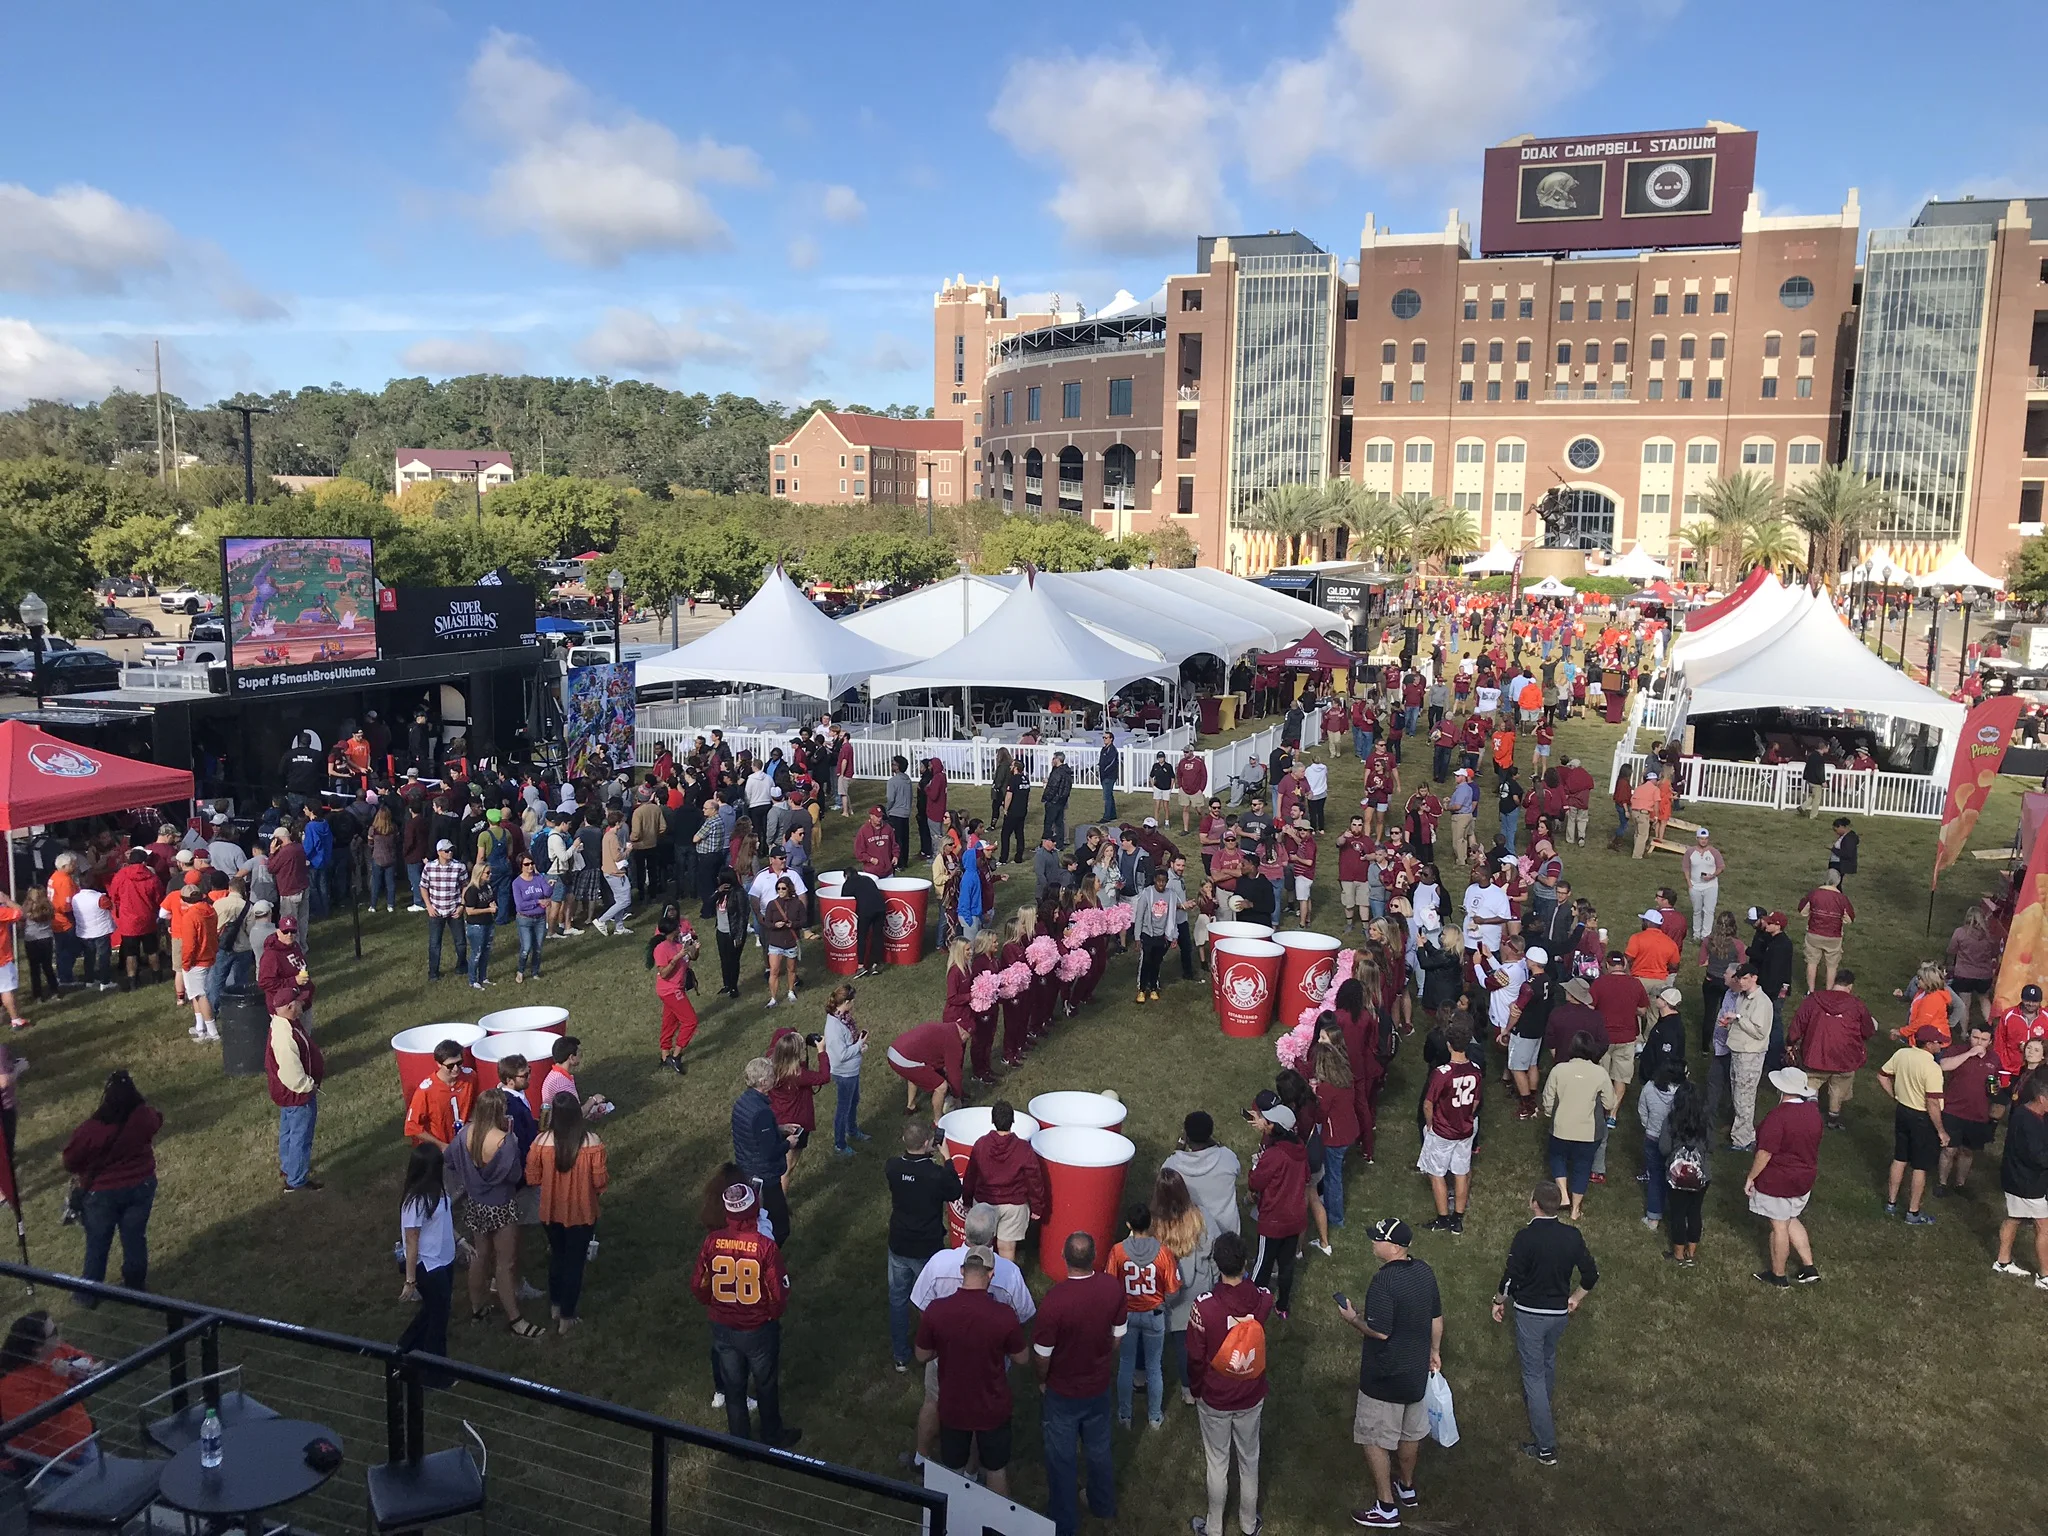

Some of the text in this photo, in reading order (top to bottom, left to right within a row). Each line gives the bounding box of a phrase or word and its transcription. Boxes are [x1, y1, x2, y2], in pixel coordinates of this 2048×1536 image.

[1521, 136, 1717, 160] DOAK CAMPBELL STADIUM
[1327, 586, 1360, 596] QLED TV
[450, 600, 482, 615] SUPER
[434, 615, 469, 634] SMASH
[444, 632, 489, 640] ULTIMATE
[238, 666, 376, 690] Super #SmashBrosUltimate
[1970, 742, 2001, 759] Pringles
[715, 1238, 758, 1253] SEMINOLES
[712, 1256, 762, 1305] 28
[1123, 1261, 1157, 1295] 23
